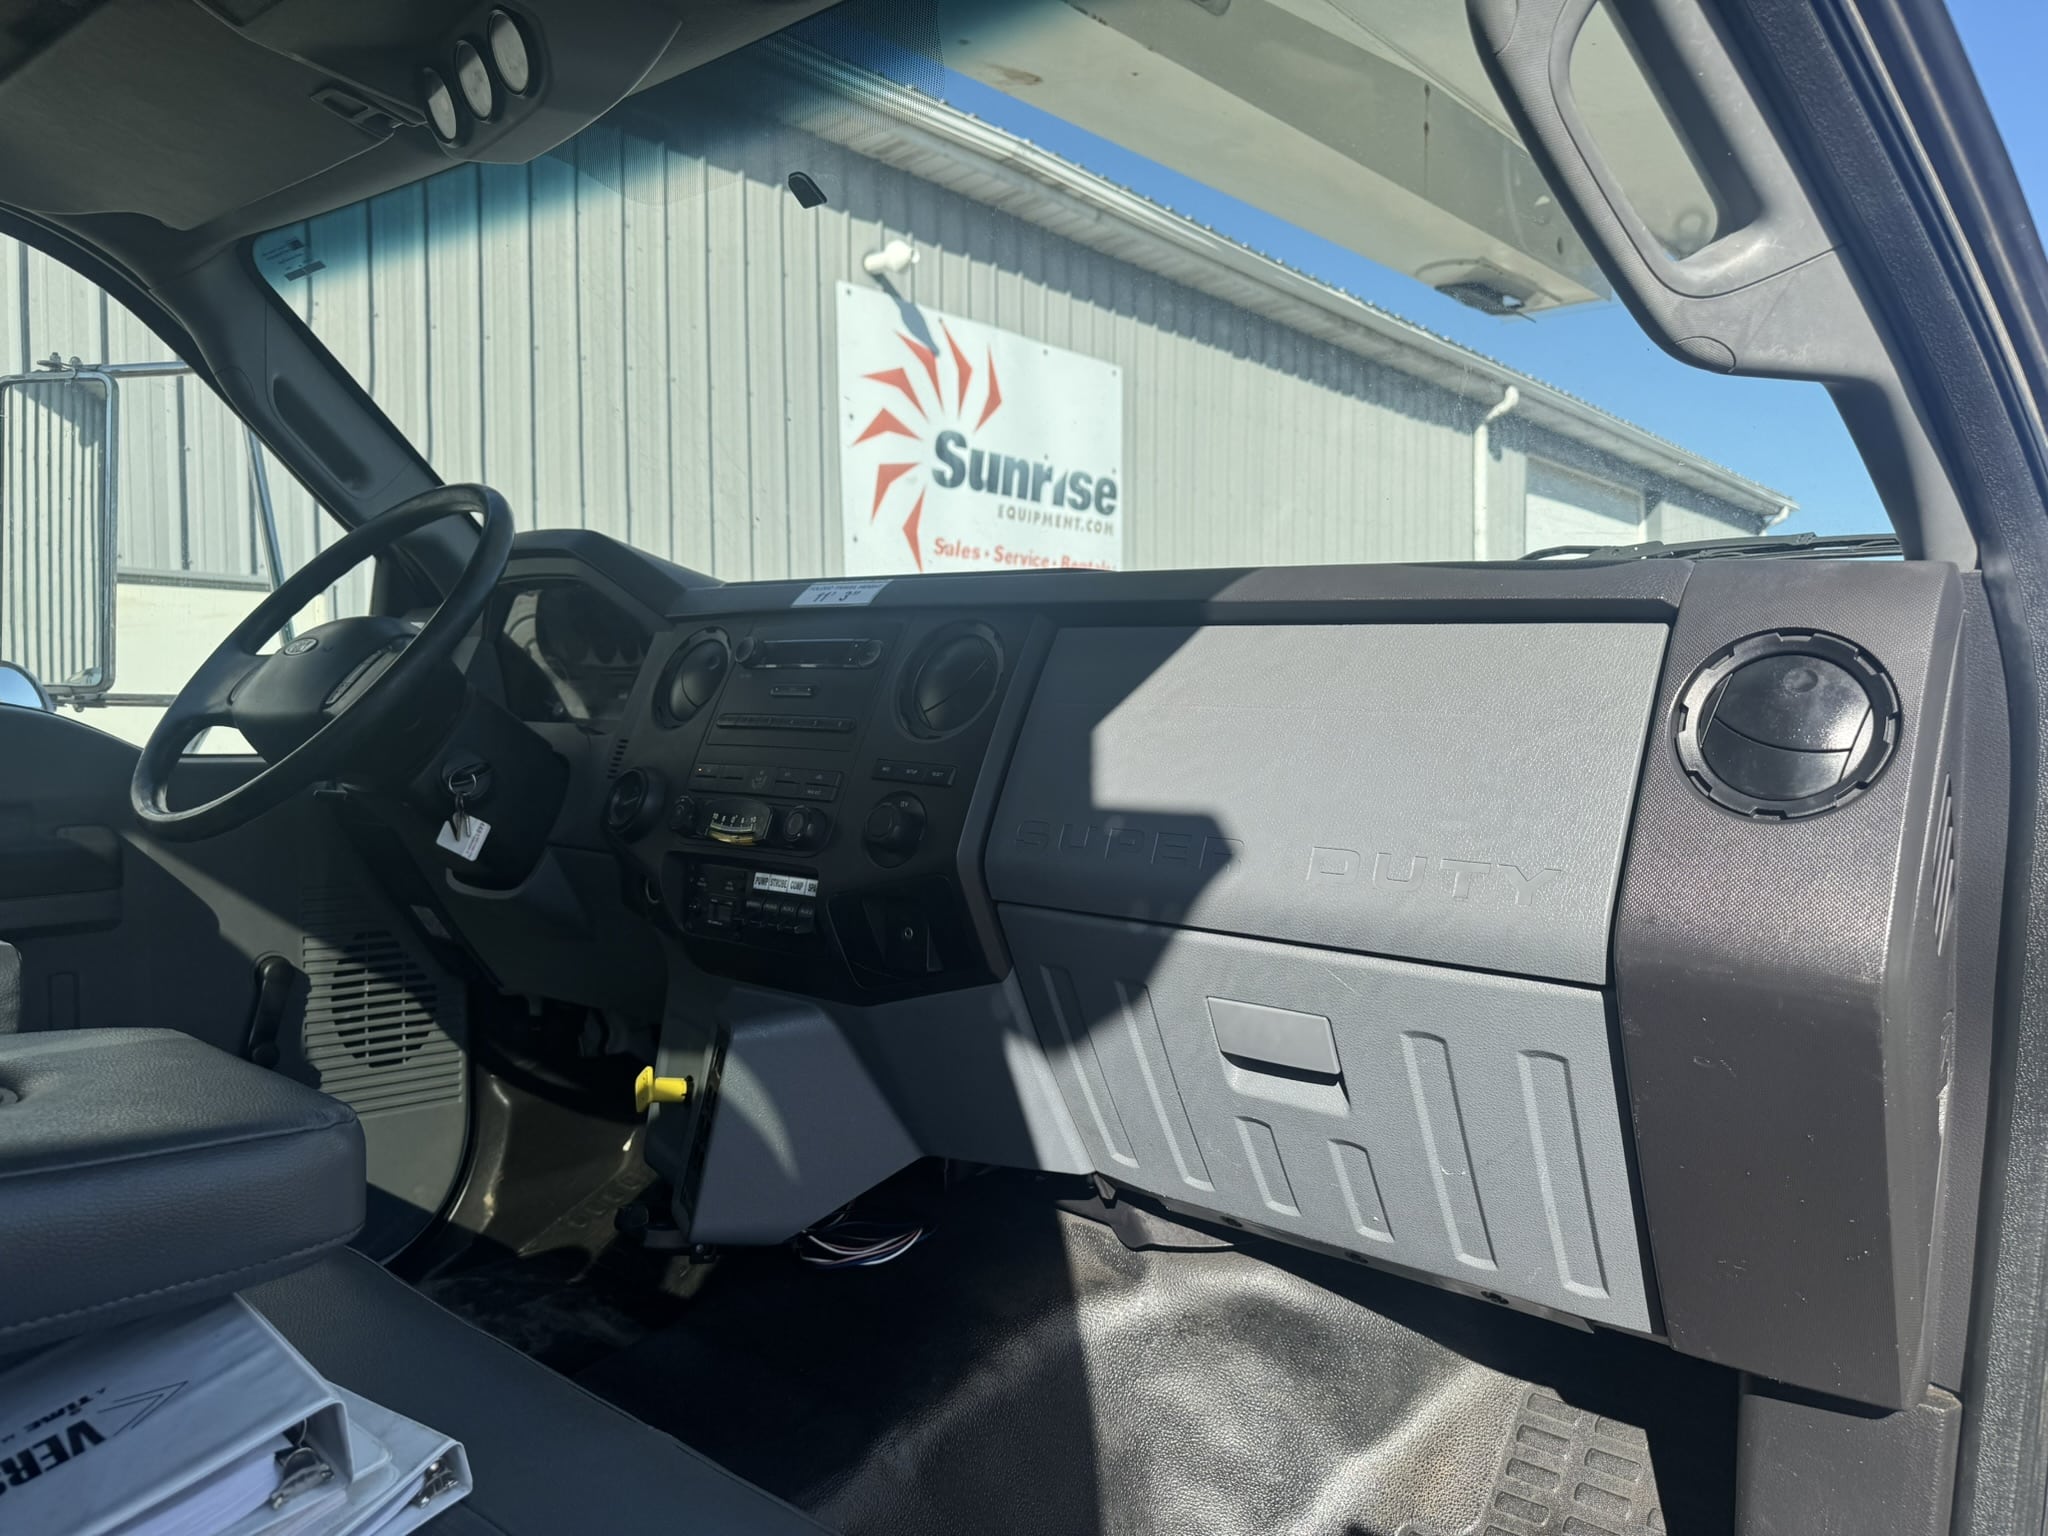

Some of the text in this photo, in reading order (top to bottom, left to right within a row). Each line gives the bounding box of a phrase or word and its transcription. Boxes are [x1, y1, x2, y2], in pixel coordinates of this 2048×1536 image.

[932, 430, 1117, 516] Sunrise
[934, 537, 980, 560] Sales
[994, 545, 1049, 568] Service
[998, 504, 1114, 536] EQUIPMENT.COM
[1015, 820, 1562, 905] SUPER DUTY
[0, 1420, 106, 1497] VER
